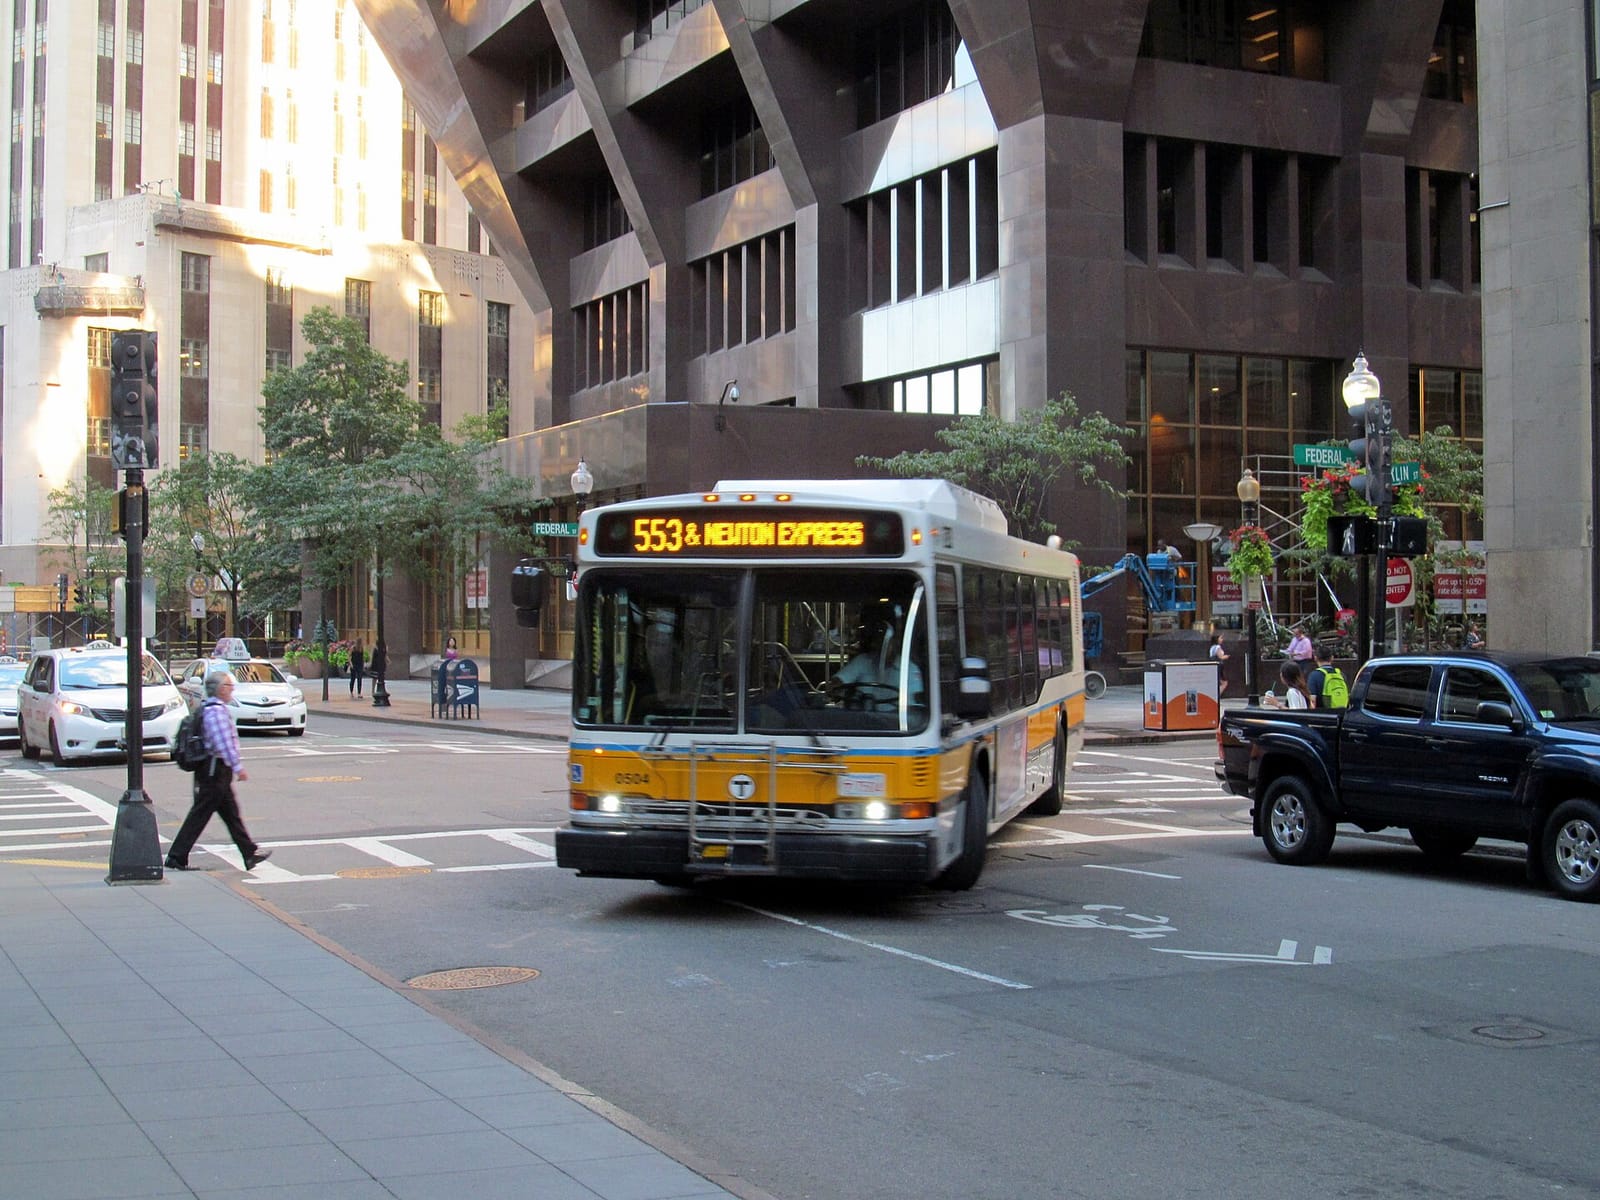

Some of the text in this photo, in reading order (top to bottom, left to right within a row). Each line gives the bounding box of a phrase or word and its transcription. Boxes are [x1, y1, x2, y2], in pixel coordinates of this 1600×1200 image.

[1305, 447, 1344, 465] FEDERAL
[535, 523, 570, 535] FEDERAL
[634, 518, 683, 552] 553
[684, 522, 701, 545] &
[777, 521, 864, 546] EXPRESS
[1393, 566, 1407, 575] NOT
[1437, 577, 1449, 585] Get
[1222, 584, 1239, 592] great
[1386, 585, 1406, 595] ENTER
[90, 641, 111, 649] TAXI
[615, 772, 650, 785] 0504
[732, 780, 750, 797] T
